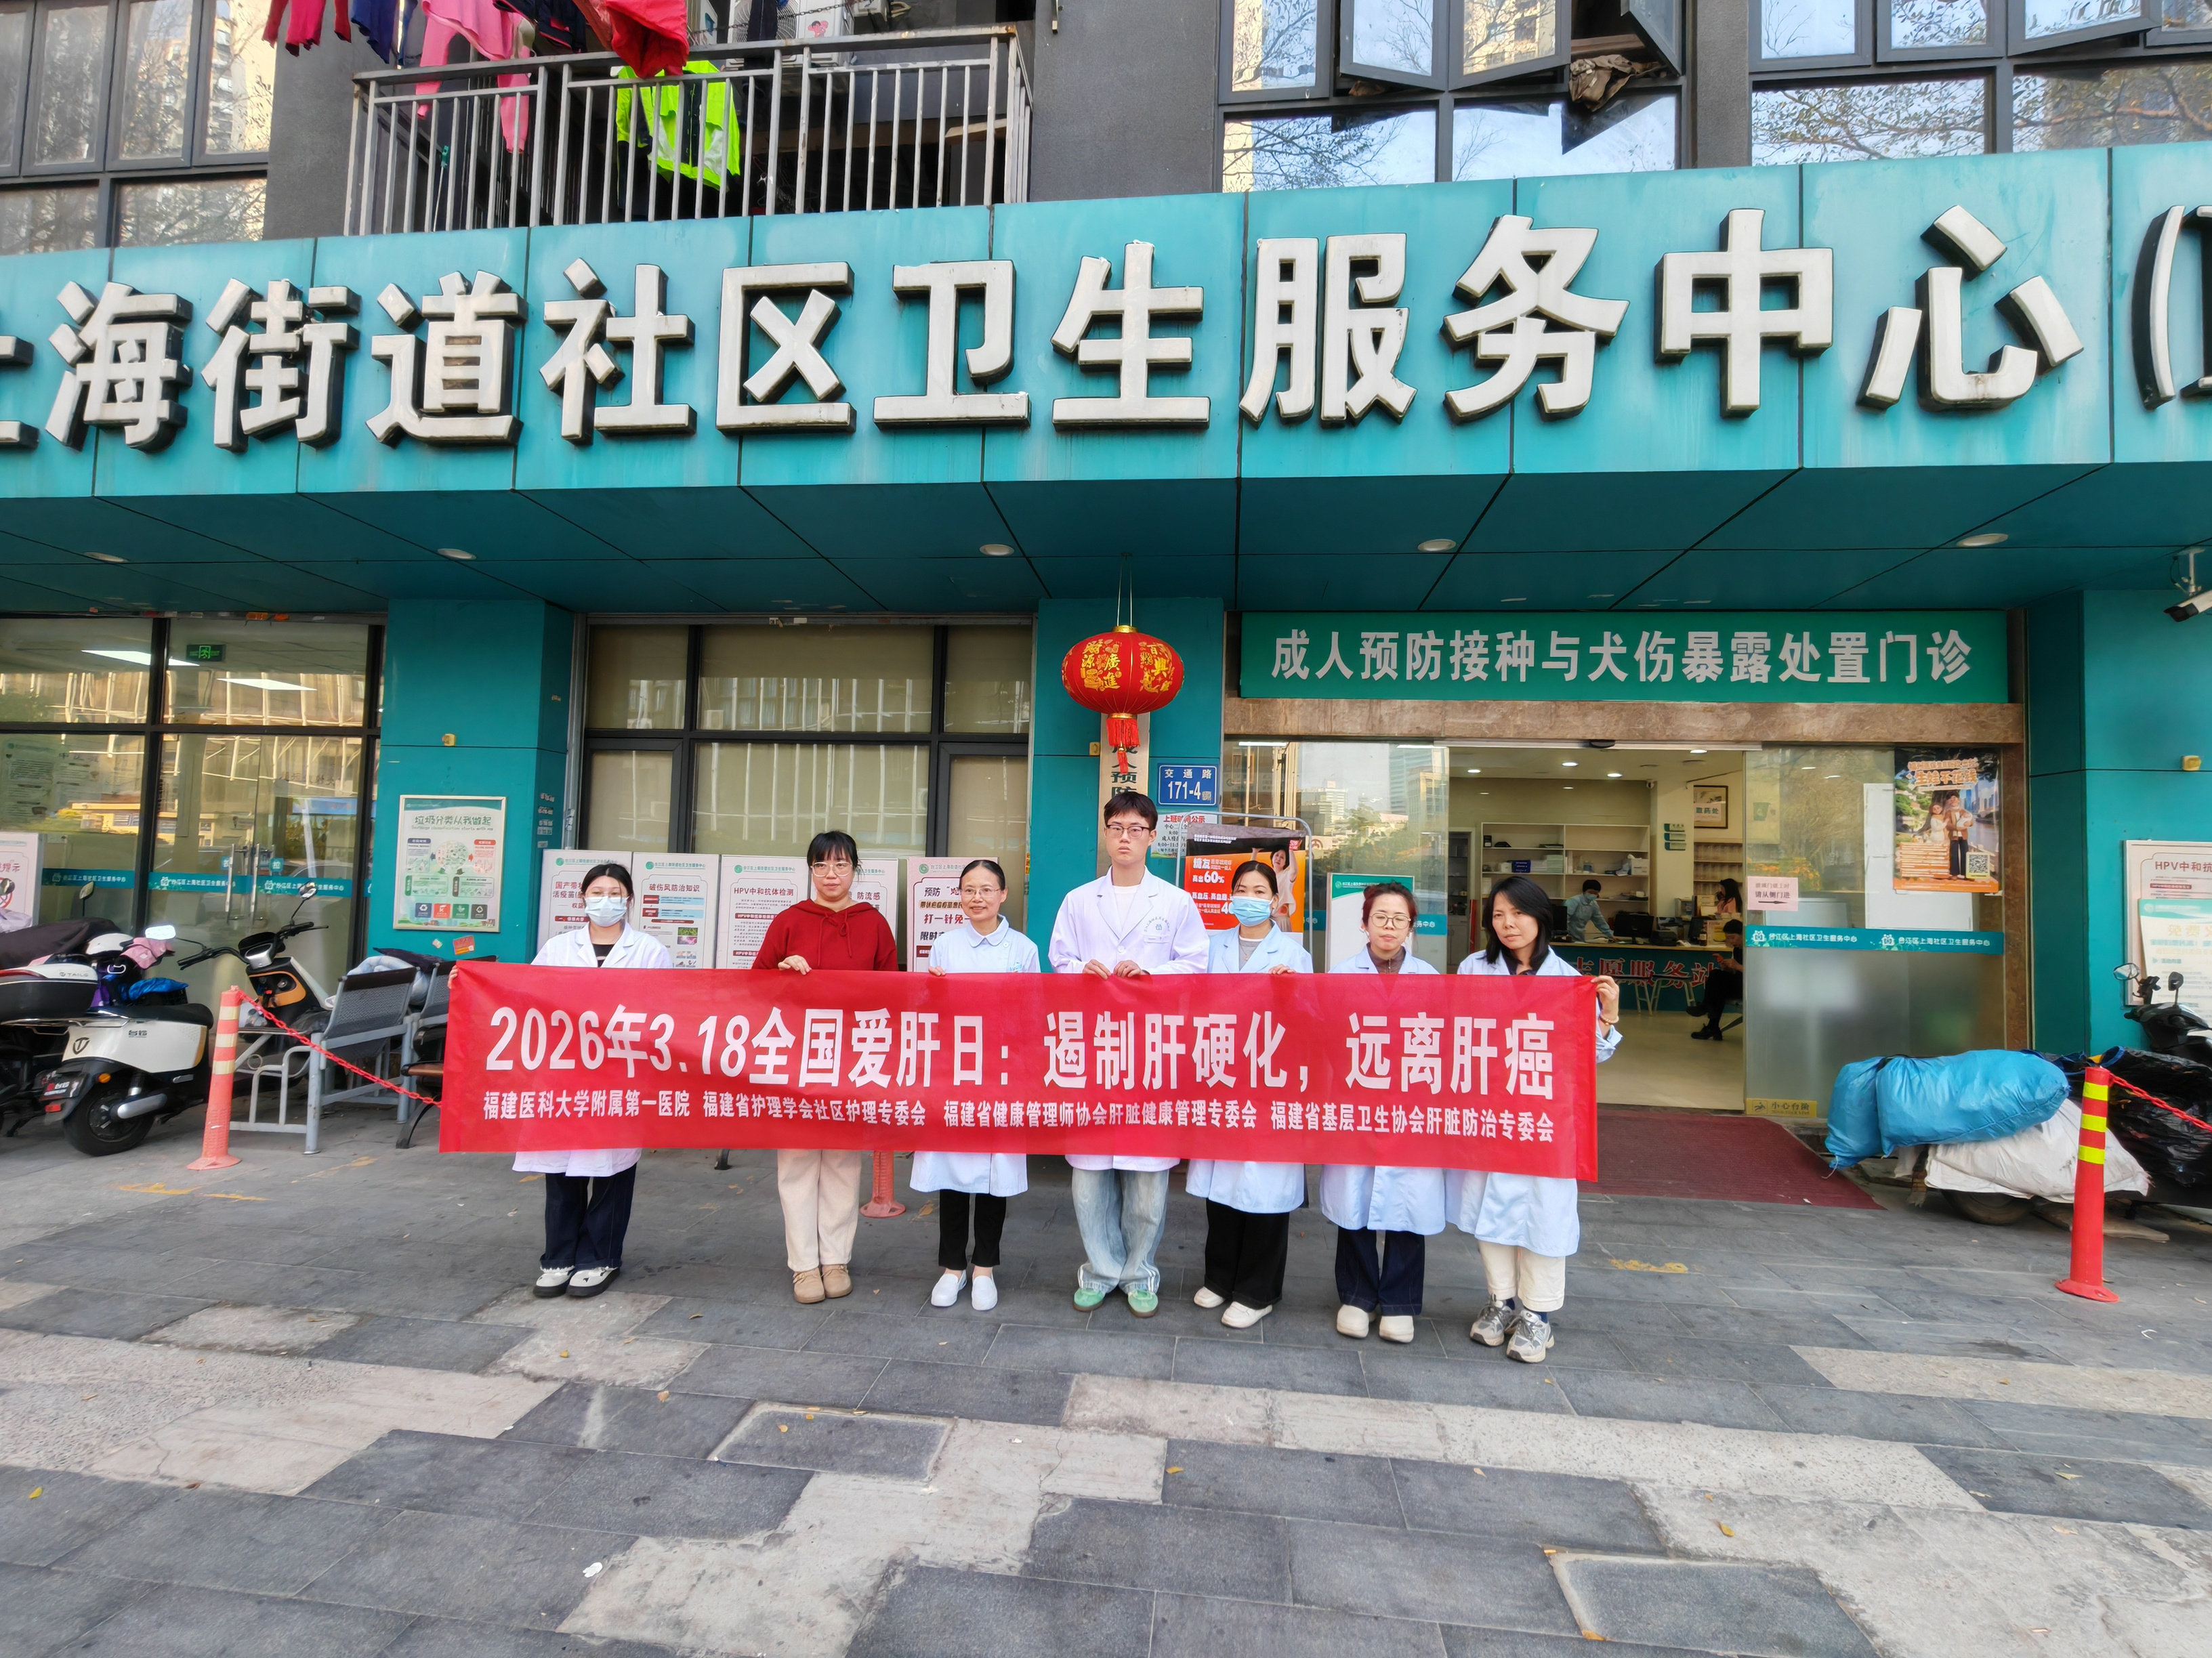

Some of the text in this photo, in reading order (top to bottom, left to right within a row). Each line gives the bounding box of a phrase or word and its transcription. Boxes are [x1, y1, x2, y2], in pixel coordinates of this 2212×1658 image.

[1271, 628, 1971, 685] 成人预防接种与犬伤暴露处置门诊
[1165, 769, 1212, 779] 交通路
[1168, 781, 1201, 800] 171-4
[415, 815, 492, 826] 垃圾分类从我做起
[0, 862, 20, 872] 提示
[649, 883, 700, 893] 破伤风防治知识
[734, 887, 794, 897] HPV中和抗体检测
[1755, 891, 1790, 899] 请从侧门进
[483, 1089, 1555, 1144] 福建医科大学附属第一医院 福建省护理学会社区护理专委会 福建省健康管理师协会肝脏健康管理专委会 福建省基层卫生协会肝脏防治专委会
